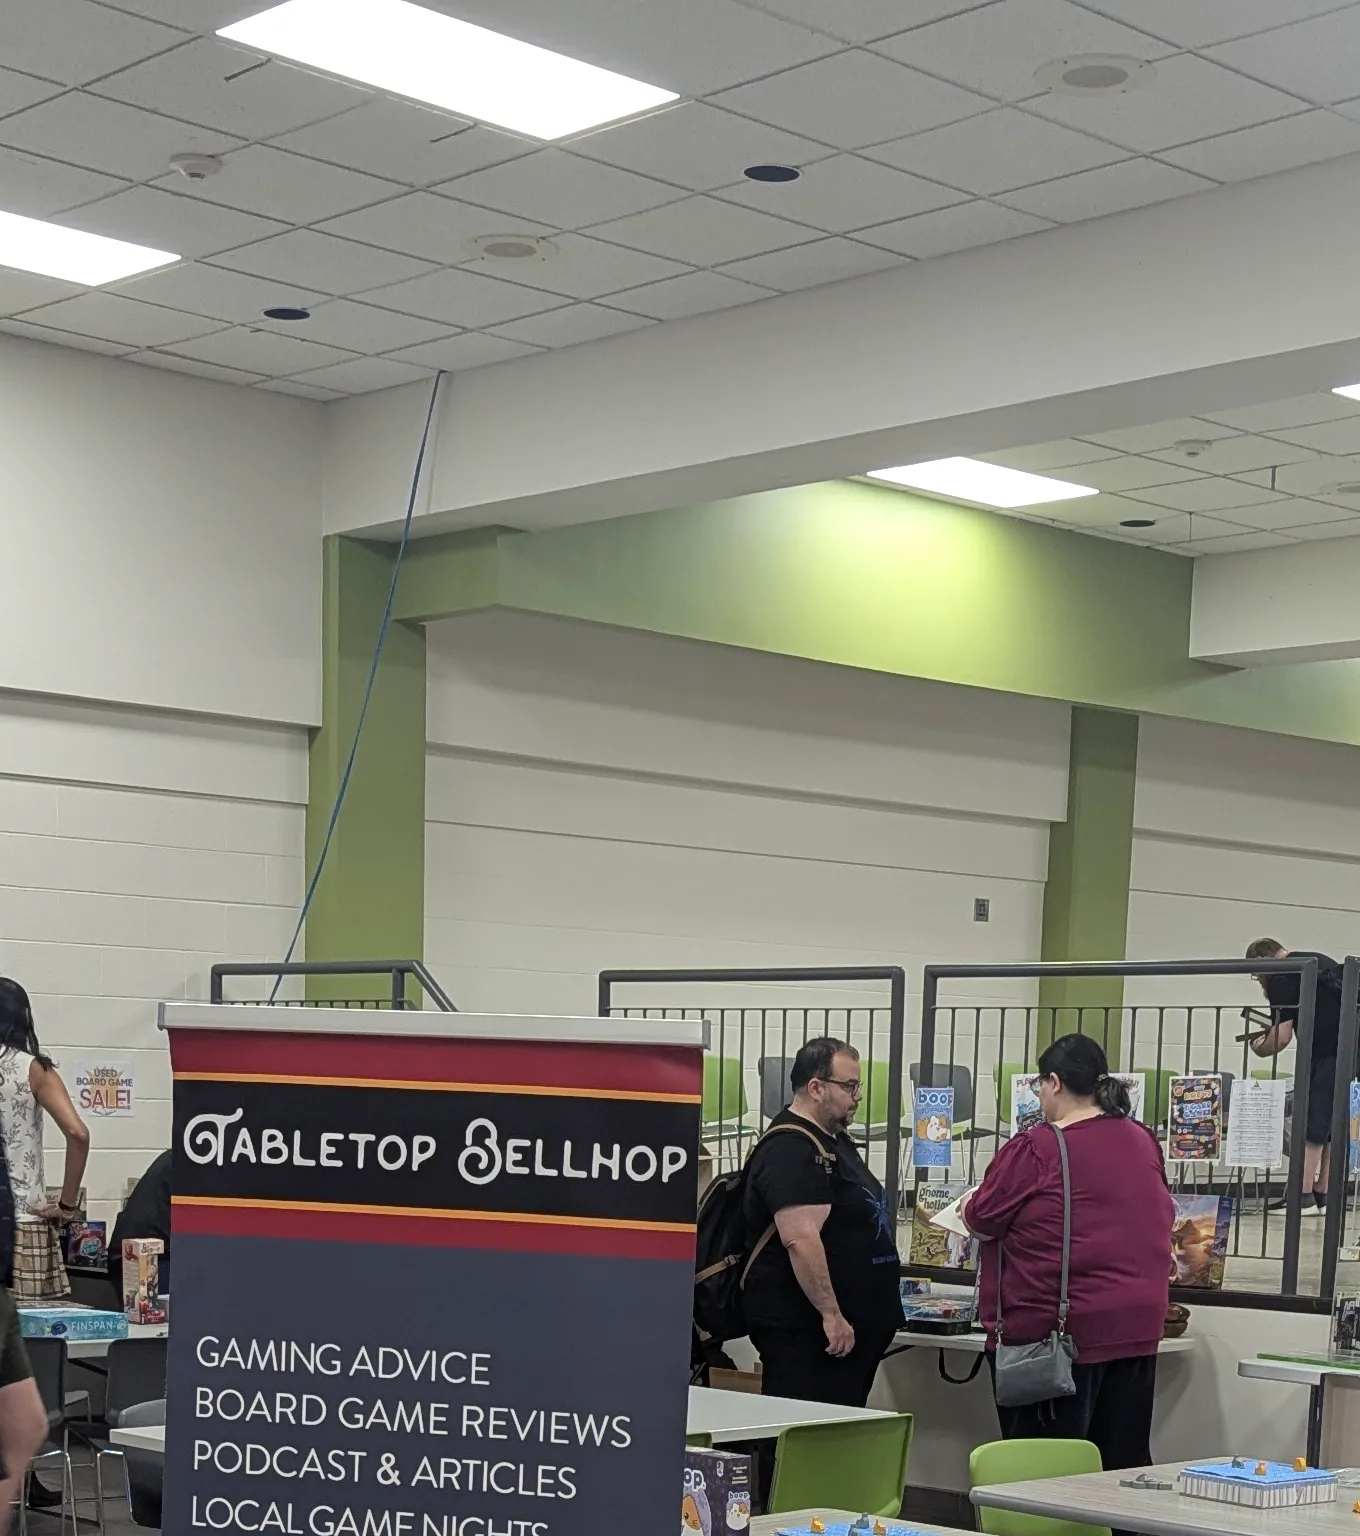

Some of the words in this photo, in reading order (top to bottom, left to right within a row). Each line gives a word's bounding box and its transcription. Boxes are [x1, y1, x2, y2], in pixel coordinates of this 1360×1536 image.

[76, 1077, 106, 1087] BOARD
[108, 1078, 133, 1087] GAME
[93, 1068, 118, 1078] USED
[79, 1089, 131, 1110] SALE!
[183, 1107, 437, 1171] TABLETOP
[457, 1117, 689, 1185] BELLHOP
[918, 1185, 950, 1202] gnome
[71, 1321, 114, 1332] FINSPAN
[196, 1335, 342, 1376] GAMING
[349, 1346, 492, 1386] ADVICE
[195, 1387, 327, 1426] BOARD
[338, 1397, 449, 1436] GAME
[461, 1406, 633, 1449] REVIEWS
[194, 1440, 367, 1483] PODCAST
[376, 1452, 402, 1487] &
[411, 1456, 578, 1500] ARTICLES
[684, 1468, 707, 1492] op.
[191, 1496, 304, 1536] LOCAL
